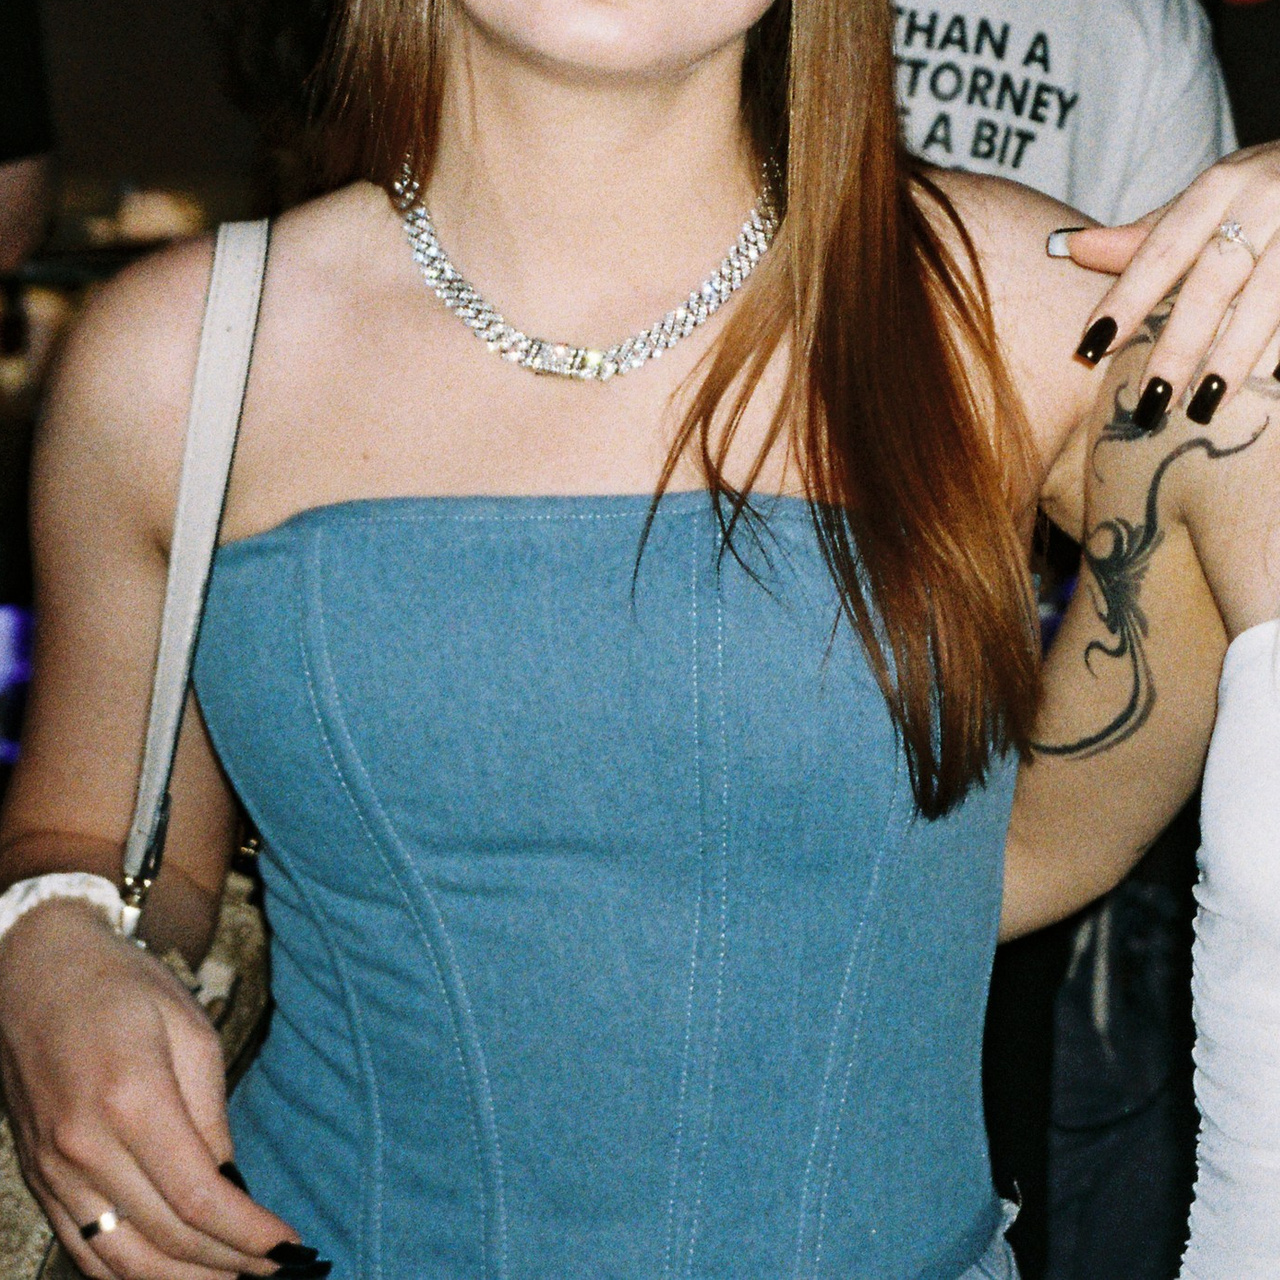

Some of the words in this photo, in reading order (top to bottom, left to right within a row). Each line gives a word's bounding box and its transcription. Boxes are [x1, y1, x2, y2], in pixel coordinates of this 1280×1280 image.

[895, 7, 1010, 60] HAN
[1023, 32, 1051, 73] A
[895, 57, 1079, 129] TORNEY
[923, 112, 953, 154] A
[971, 120, 1036, 168] BIT
